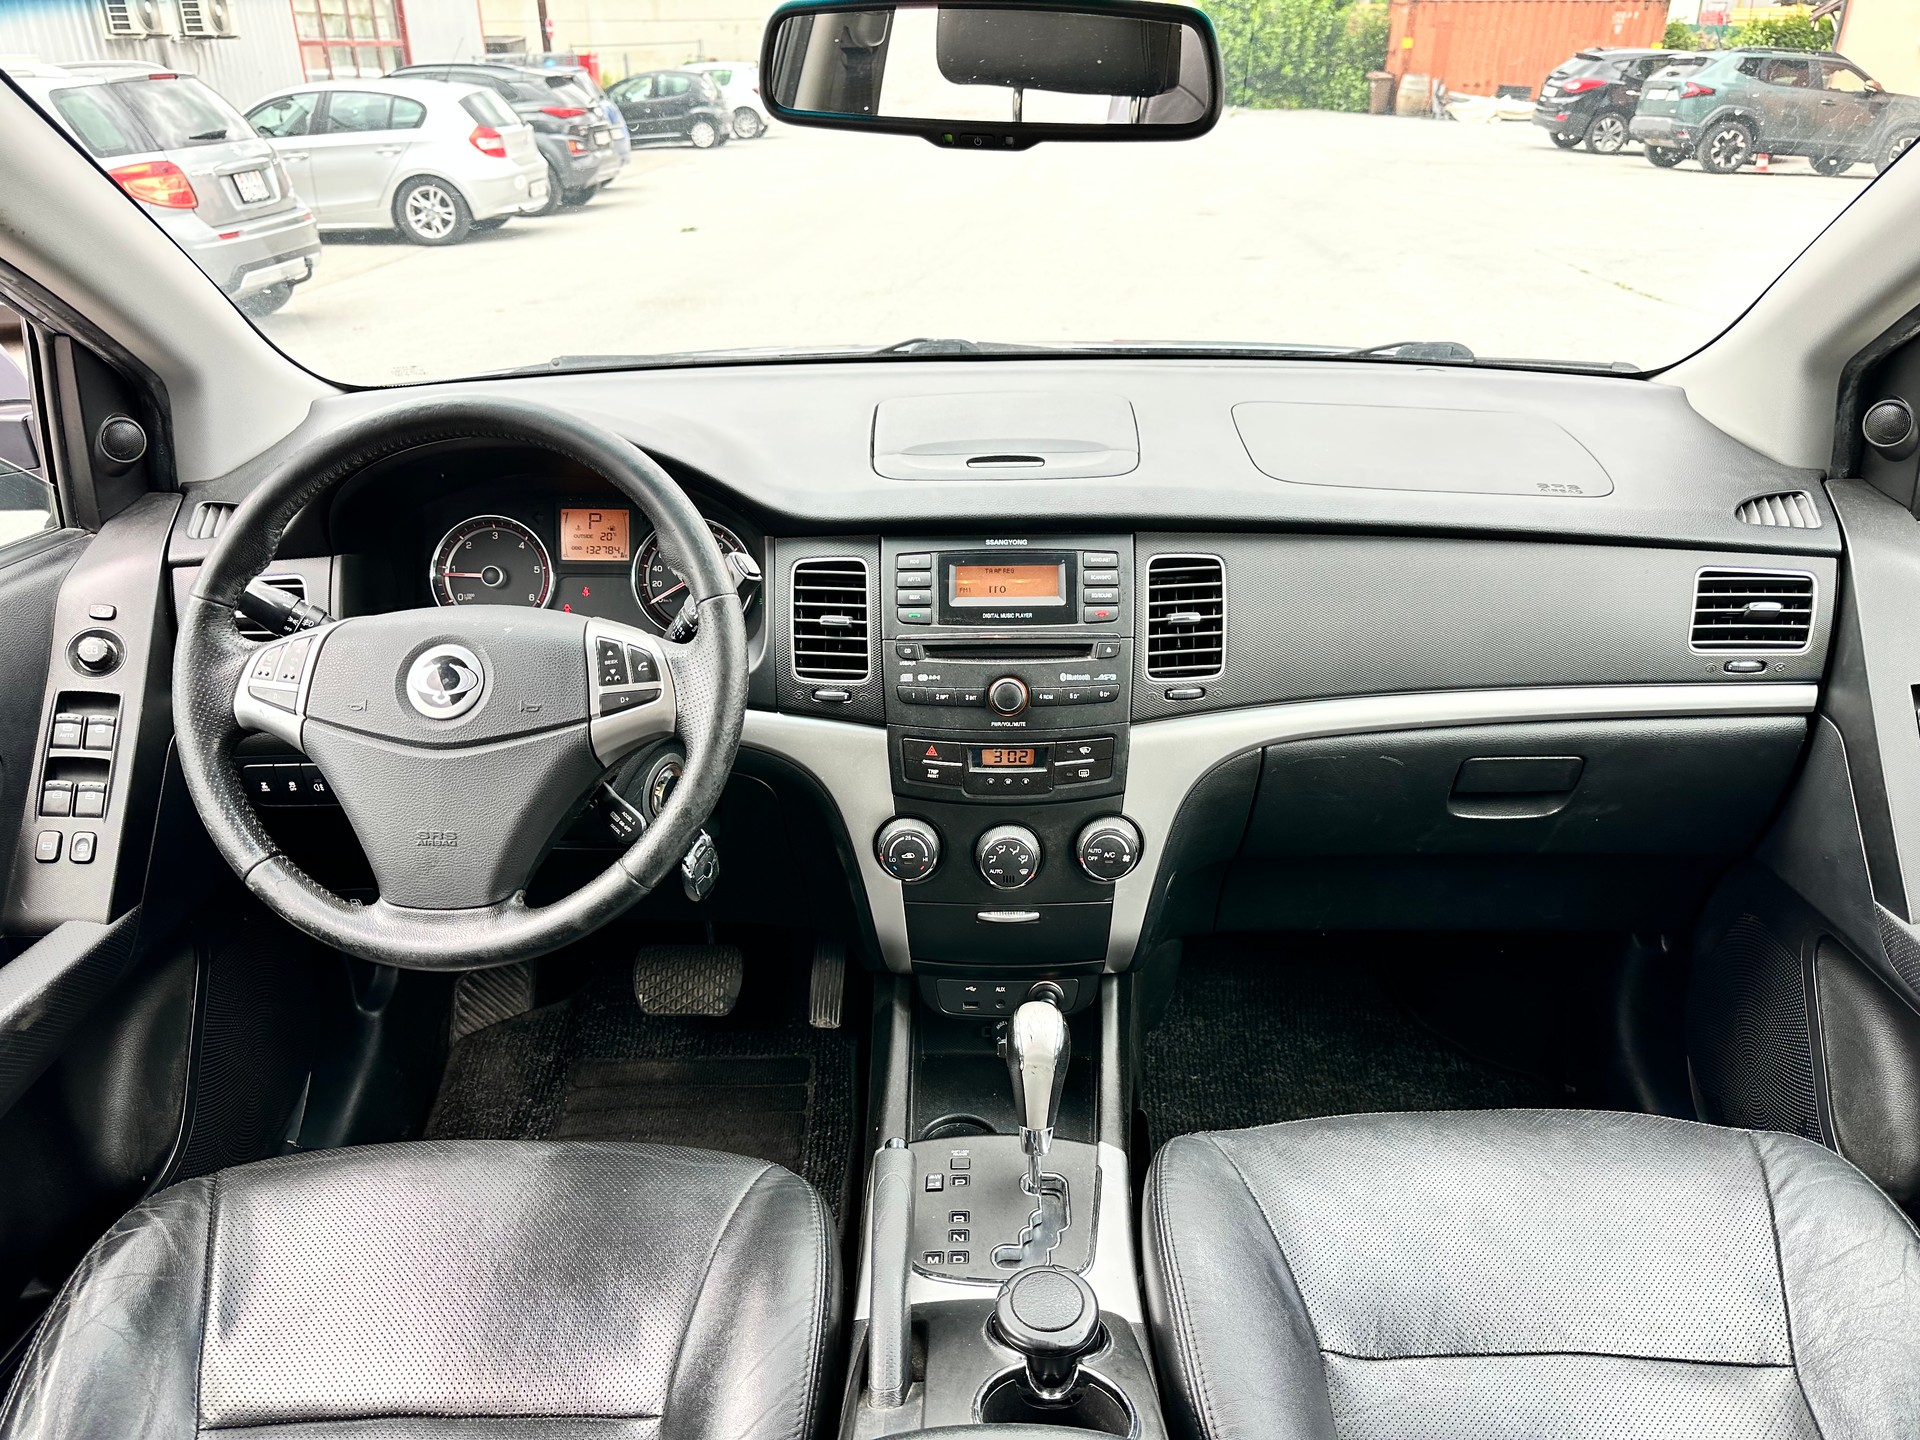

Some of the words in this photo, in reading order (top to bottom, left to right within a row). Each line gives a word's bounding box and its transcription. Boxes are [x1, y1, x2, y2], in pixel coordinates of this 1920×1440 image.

[589, 513, 602, 529] P
[586, 546, 620, 554] 132784
[457, 593, 464, 601] 0
[417, 831, 458, 840] SRS
[927, 1256, 939, 1264] M
[953, 1255, 965, 1263] D
